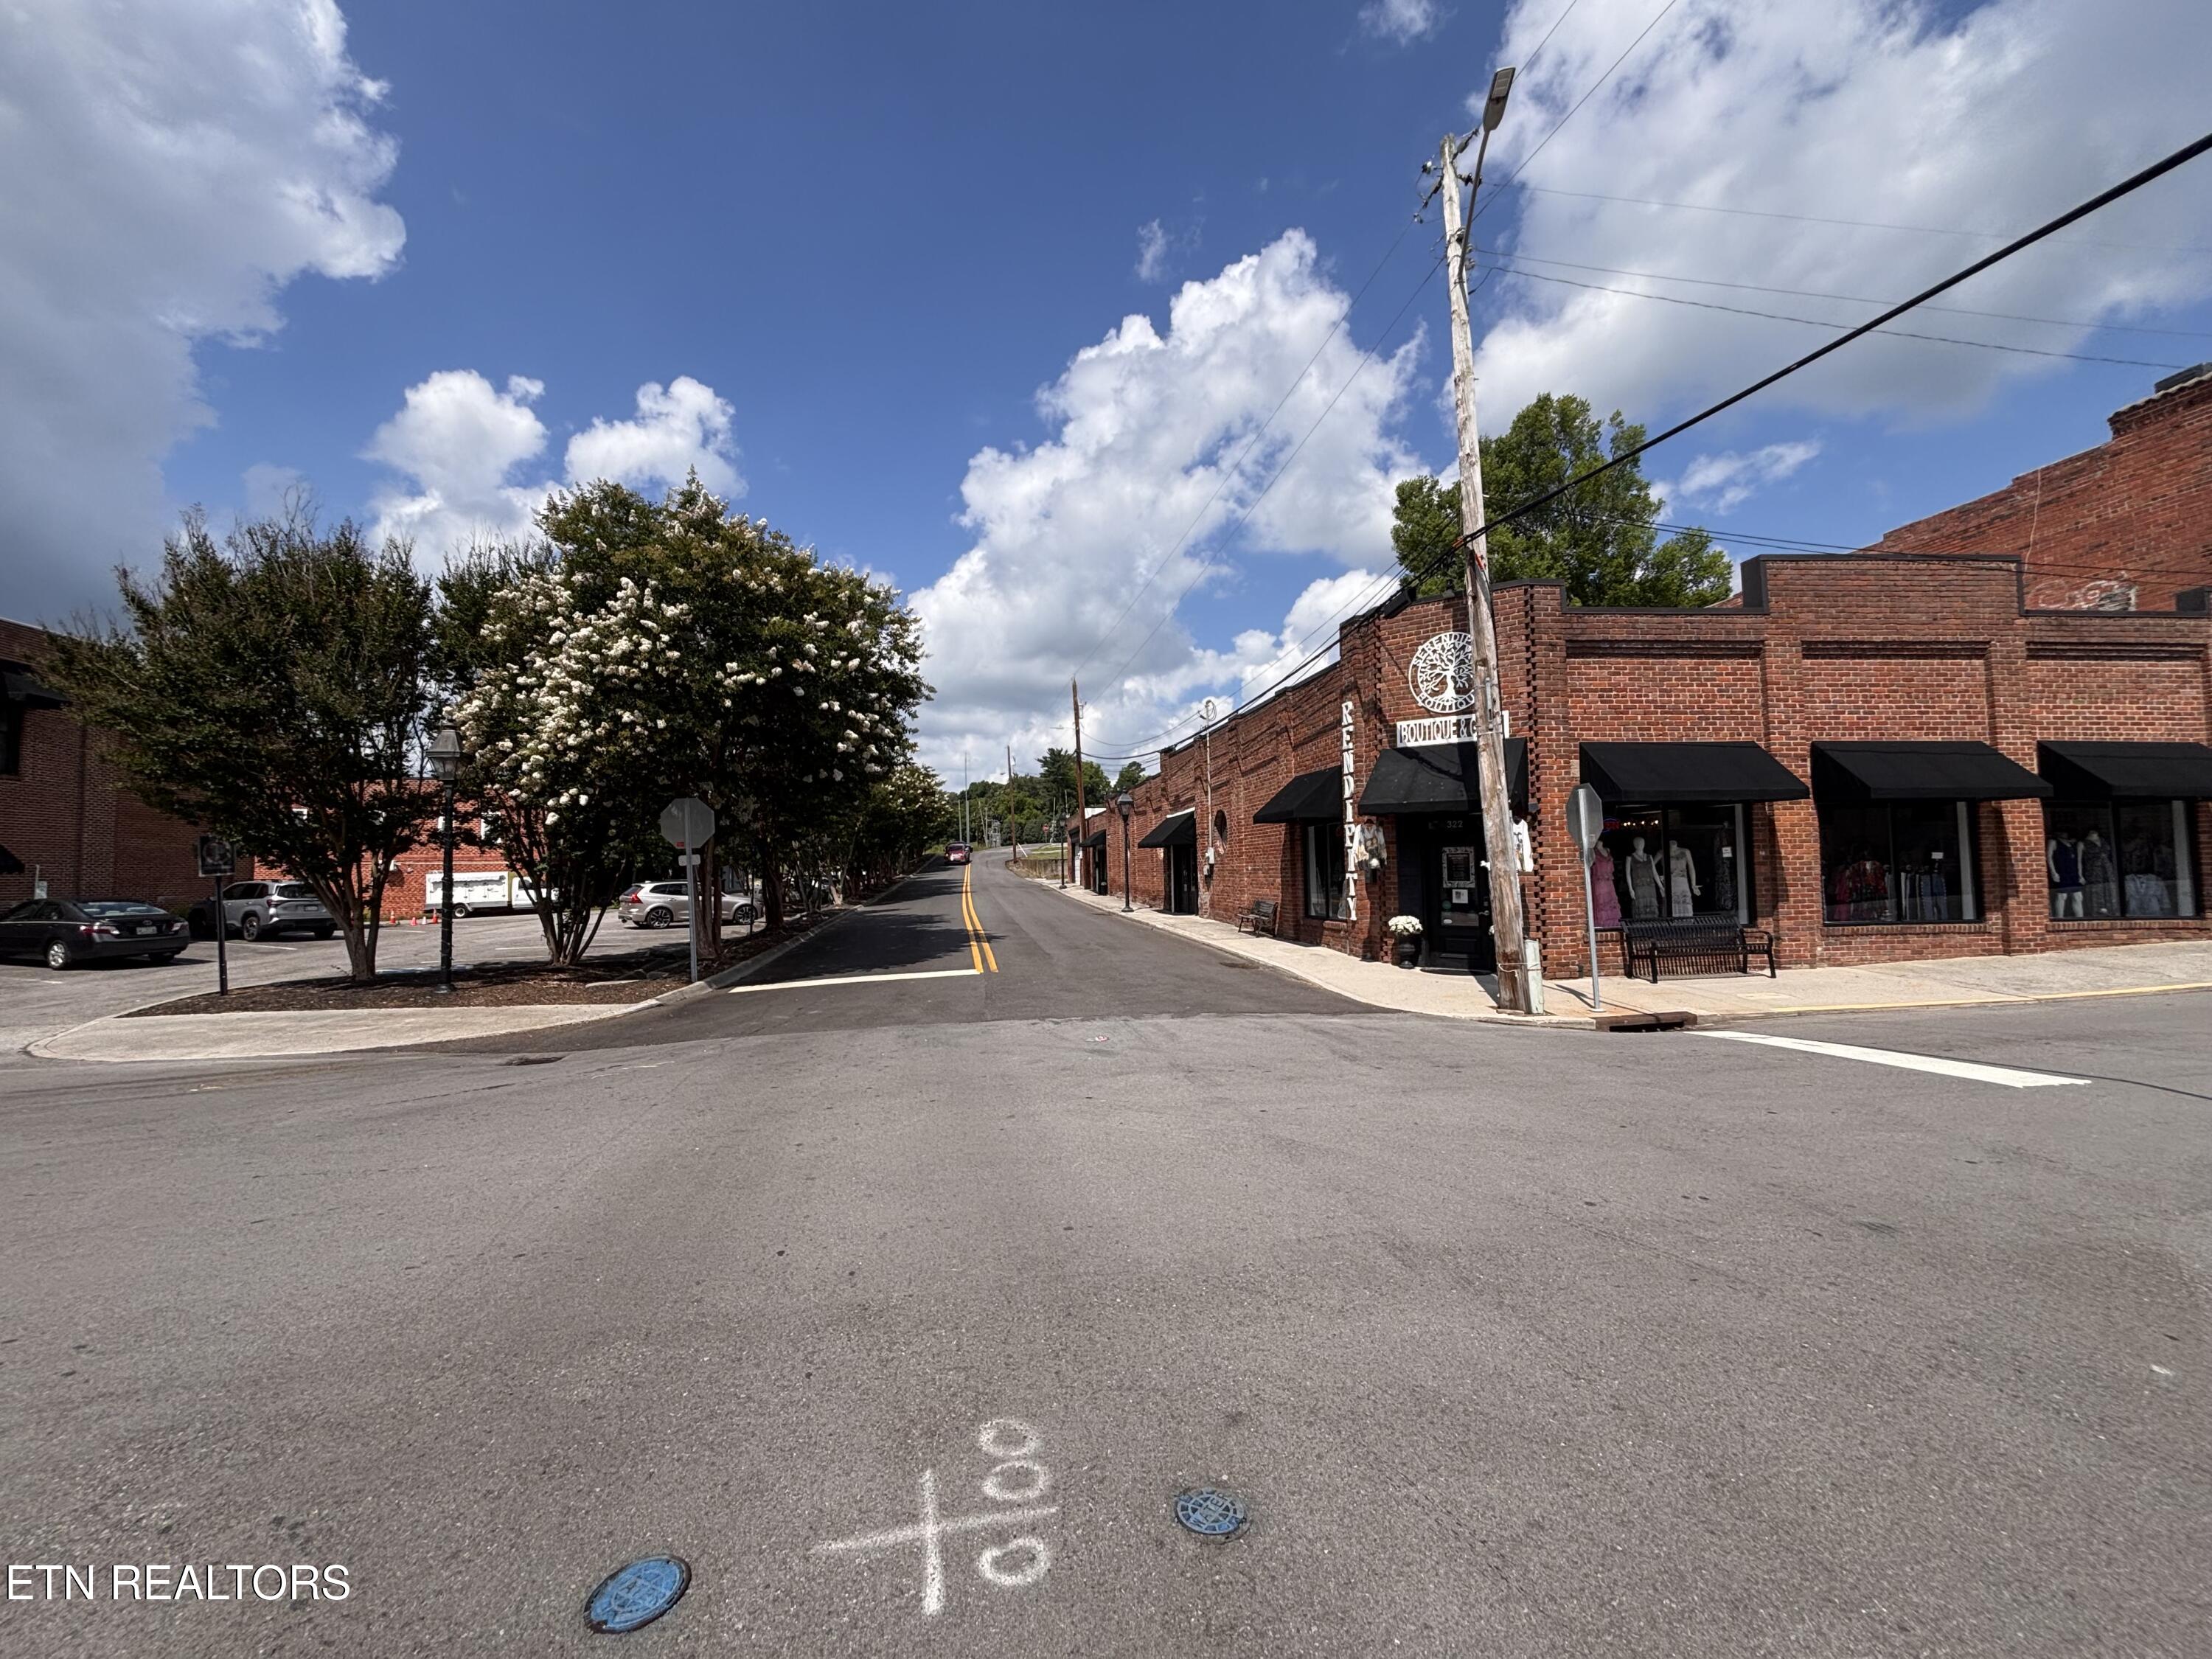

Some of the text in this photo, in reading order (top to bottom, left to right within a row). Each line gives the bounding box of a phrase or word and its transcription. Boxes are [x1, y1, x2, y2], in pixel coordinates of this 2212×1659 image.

[1413, 634, 1472, 667] SERENDIP
[1418, 692, 1475, 711] BOUTIQU
[1402, 719, 1457, 742] BOUTIQUE
[1460, 718, 1467, 737] &
